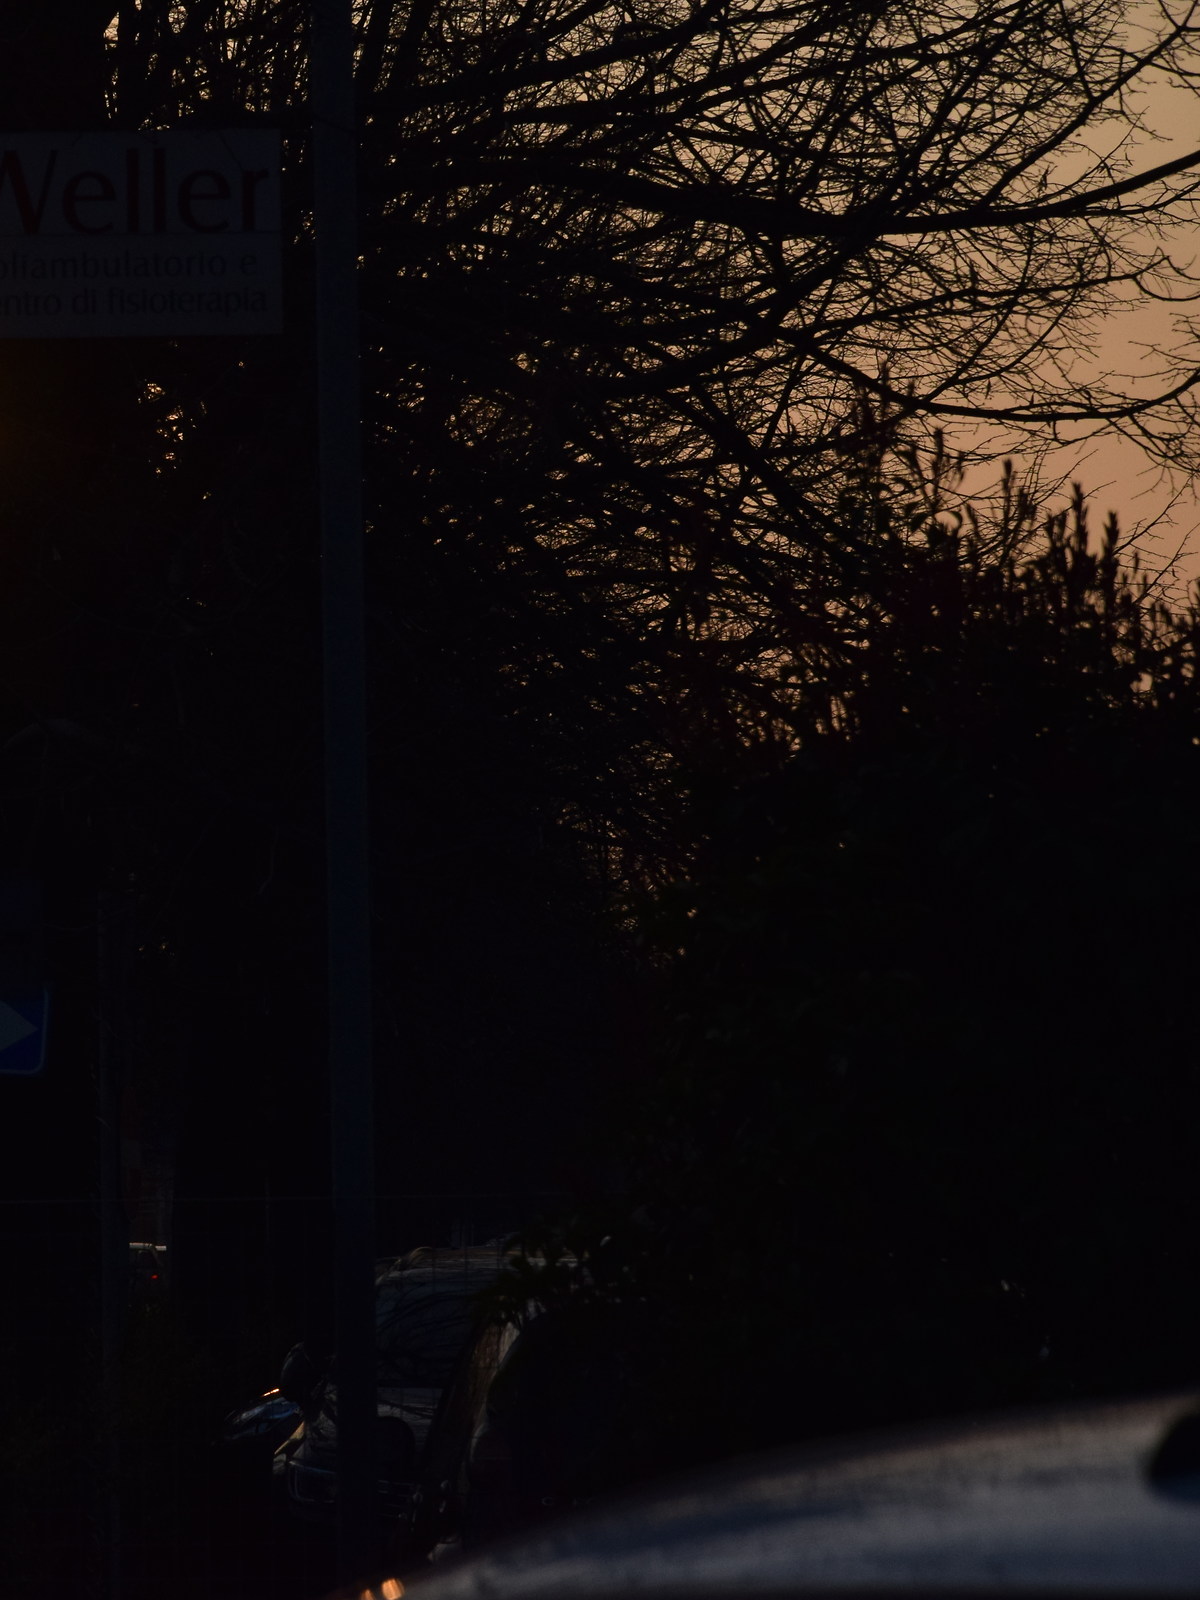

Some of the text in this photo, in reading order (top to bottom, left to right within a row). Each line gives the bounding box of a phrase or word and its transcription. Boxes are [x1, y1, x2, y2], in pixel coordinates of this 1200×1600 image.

[239, 252, 258, 277] e
[71, 288, 98, 315] di
[107, 285, 269, 318] fisioterapia
